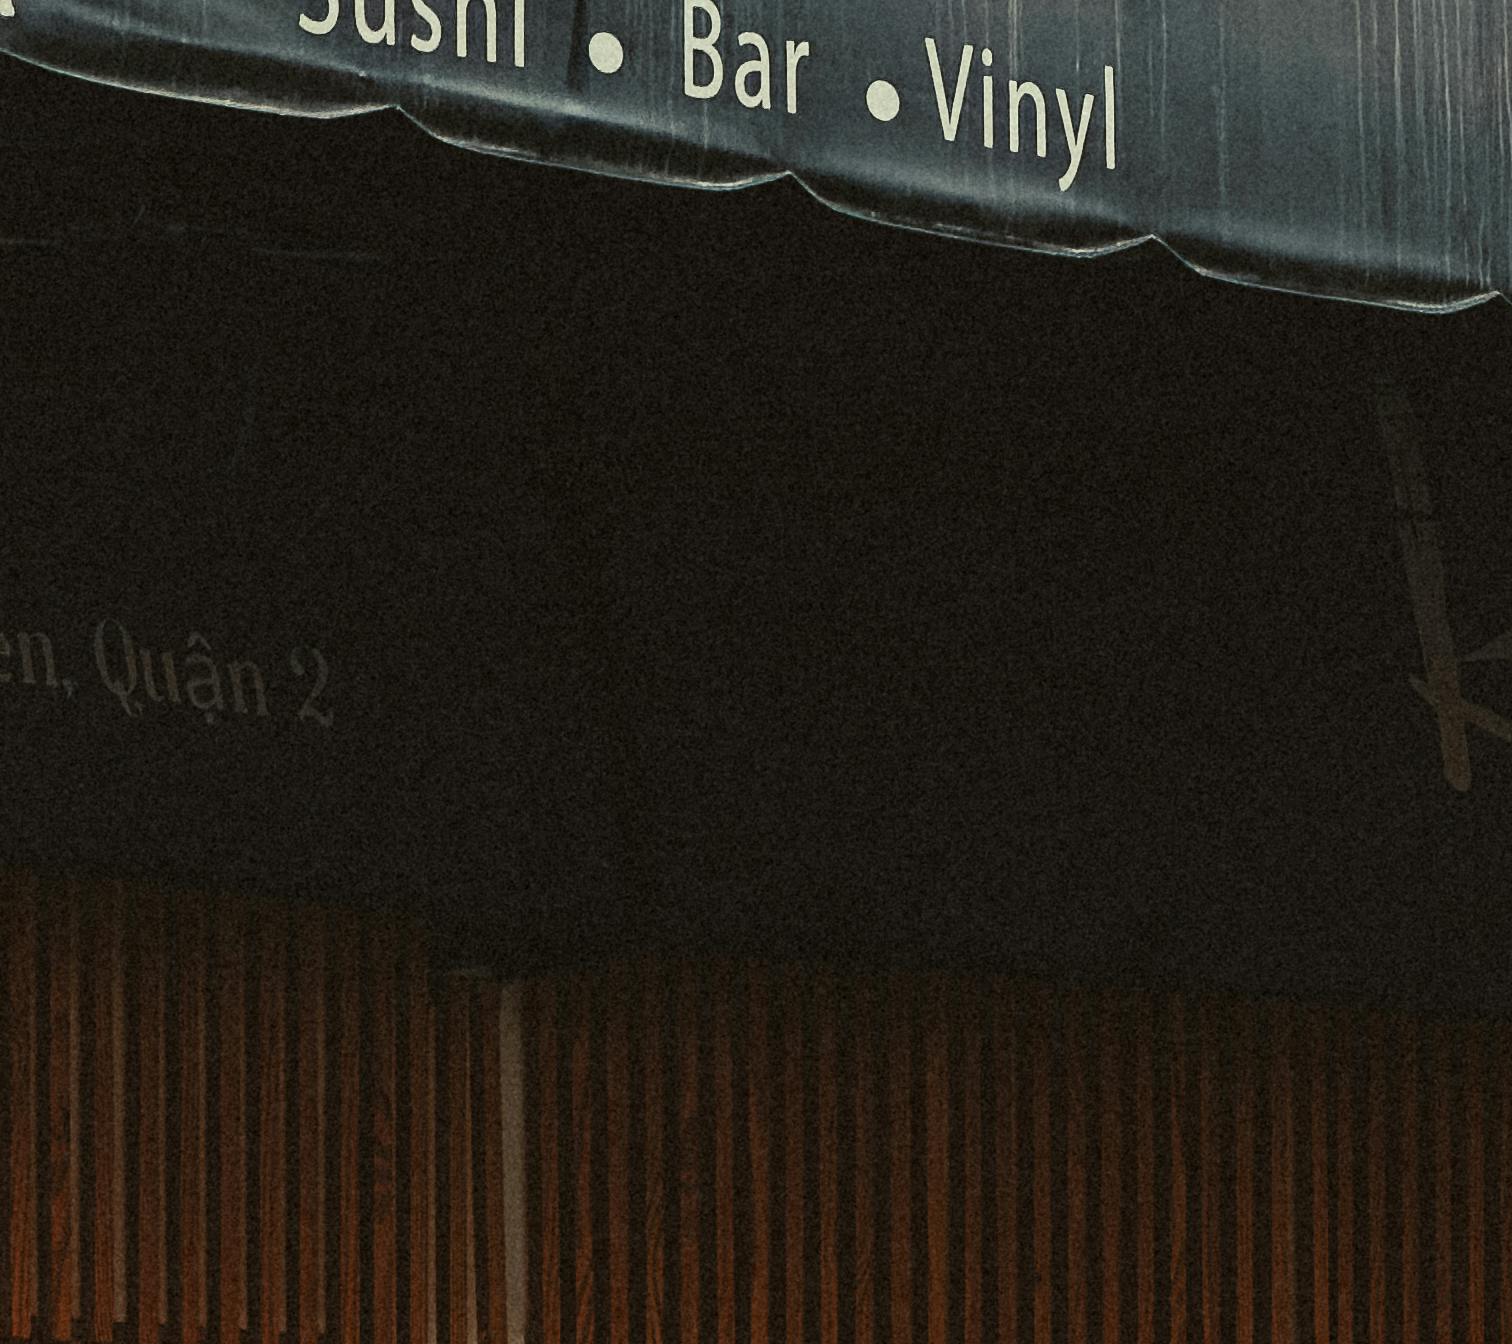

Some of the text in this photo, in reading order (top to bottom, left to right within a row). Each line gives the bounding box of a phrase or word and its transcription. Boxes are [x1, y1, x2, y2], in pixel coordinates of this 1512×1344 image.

[683, 0, 810, 115] Bar
[924, 37, 1117, 192] Vinyl
[94, 618, 270, 725] Quận
[290, 642, 335, 728] 2
